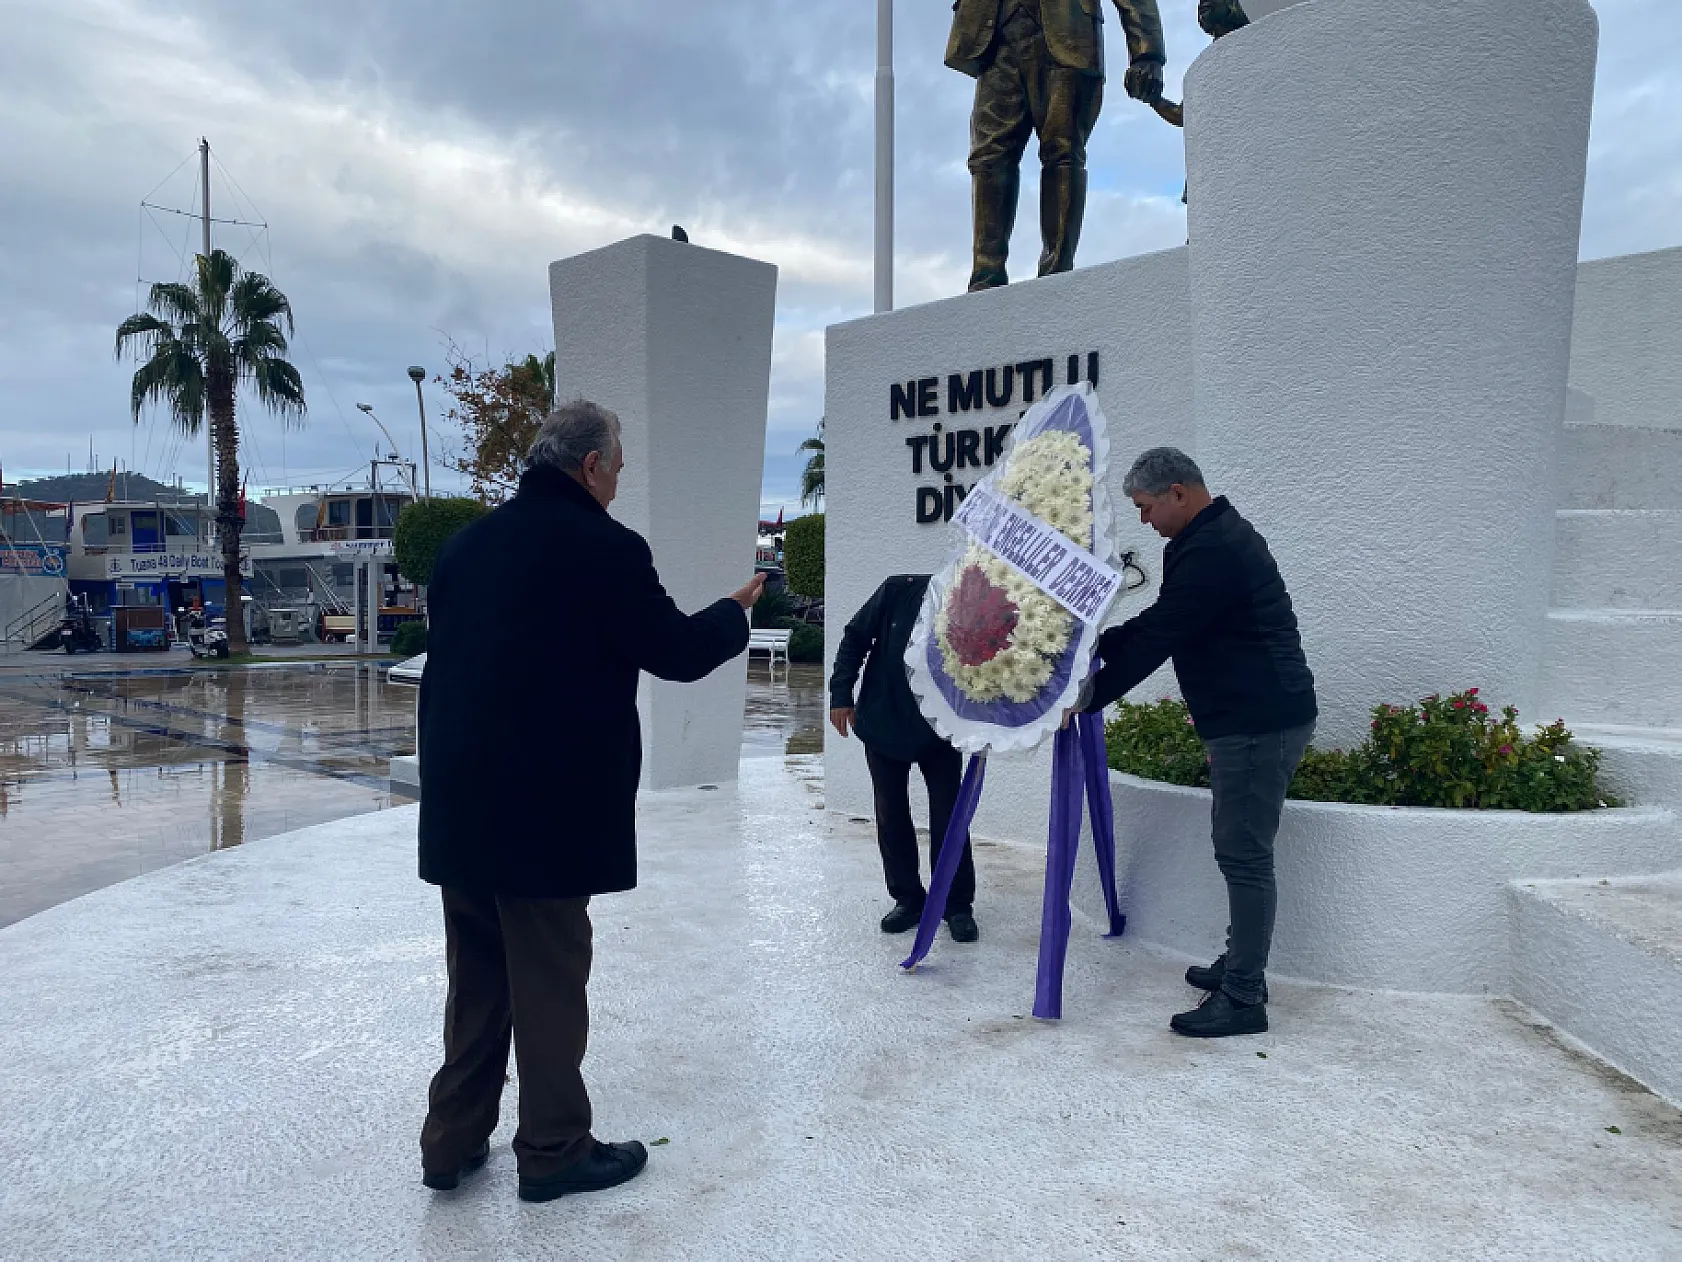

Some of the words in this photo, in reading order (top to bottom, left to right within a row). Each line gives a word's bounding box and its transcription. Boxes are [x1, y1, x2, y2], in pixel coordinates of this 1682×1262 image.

[890, 377, 940, 420] NE
[905, 412, 1024, 474] TÜRK
[169, 553, 190, 571] Daily
[191, 554, 209, 569] Boat
